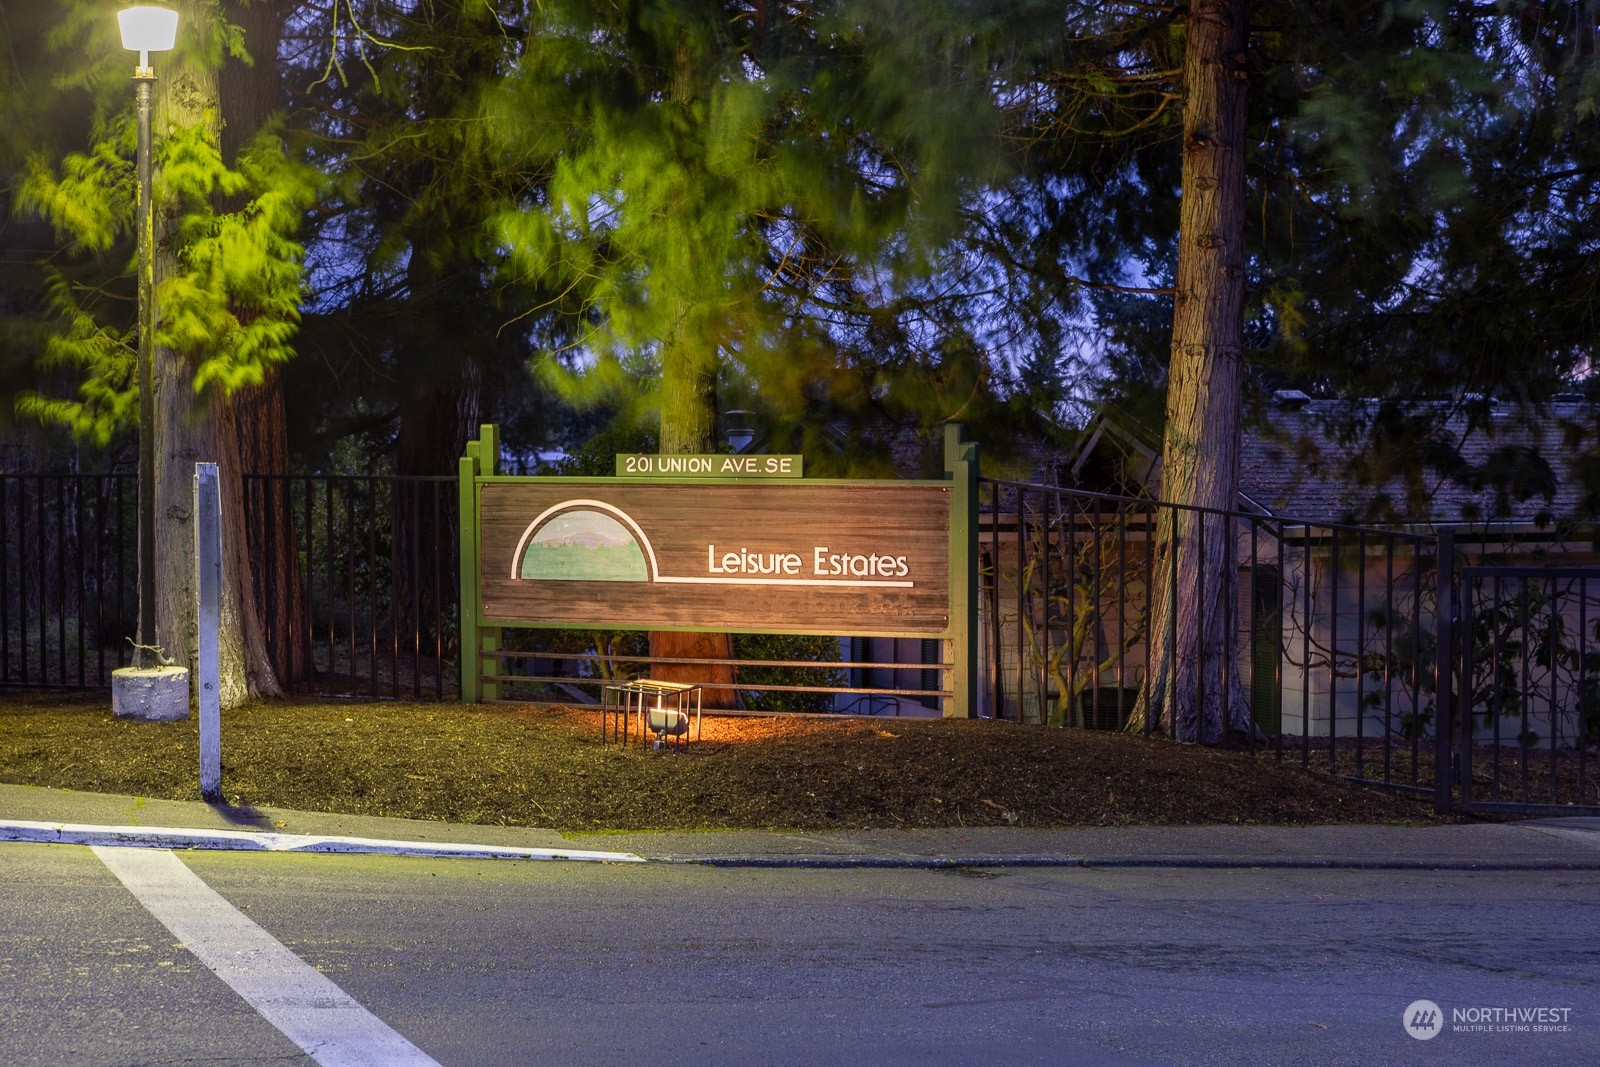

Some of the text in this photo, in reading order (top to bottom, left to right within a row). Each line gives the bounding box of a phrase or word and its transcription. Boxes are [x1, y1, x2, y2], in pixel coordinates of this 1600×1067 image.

[626, 457, 653, 472] 201
[658, 457, 712, 473] UNION
[708, 544, 909, 577] Leisure Estates
